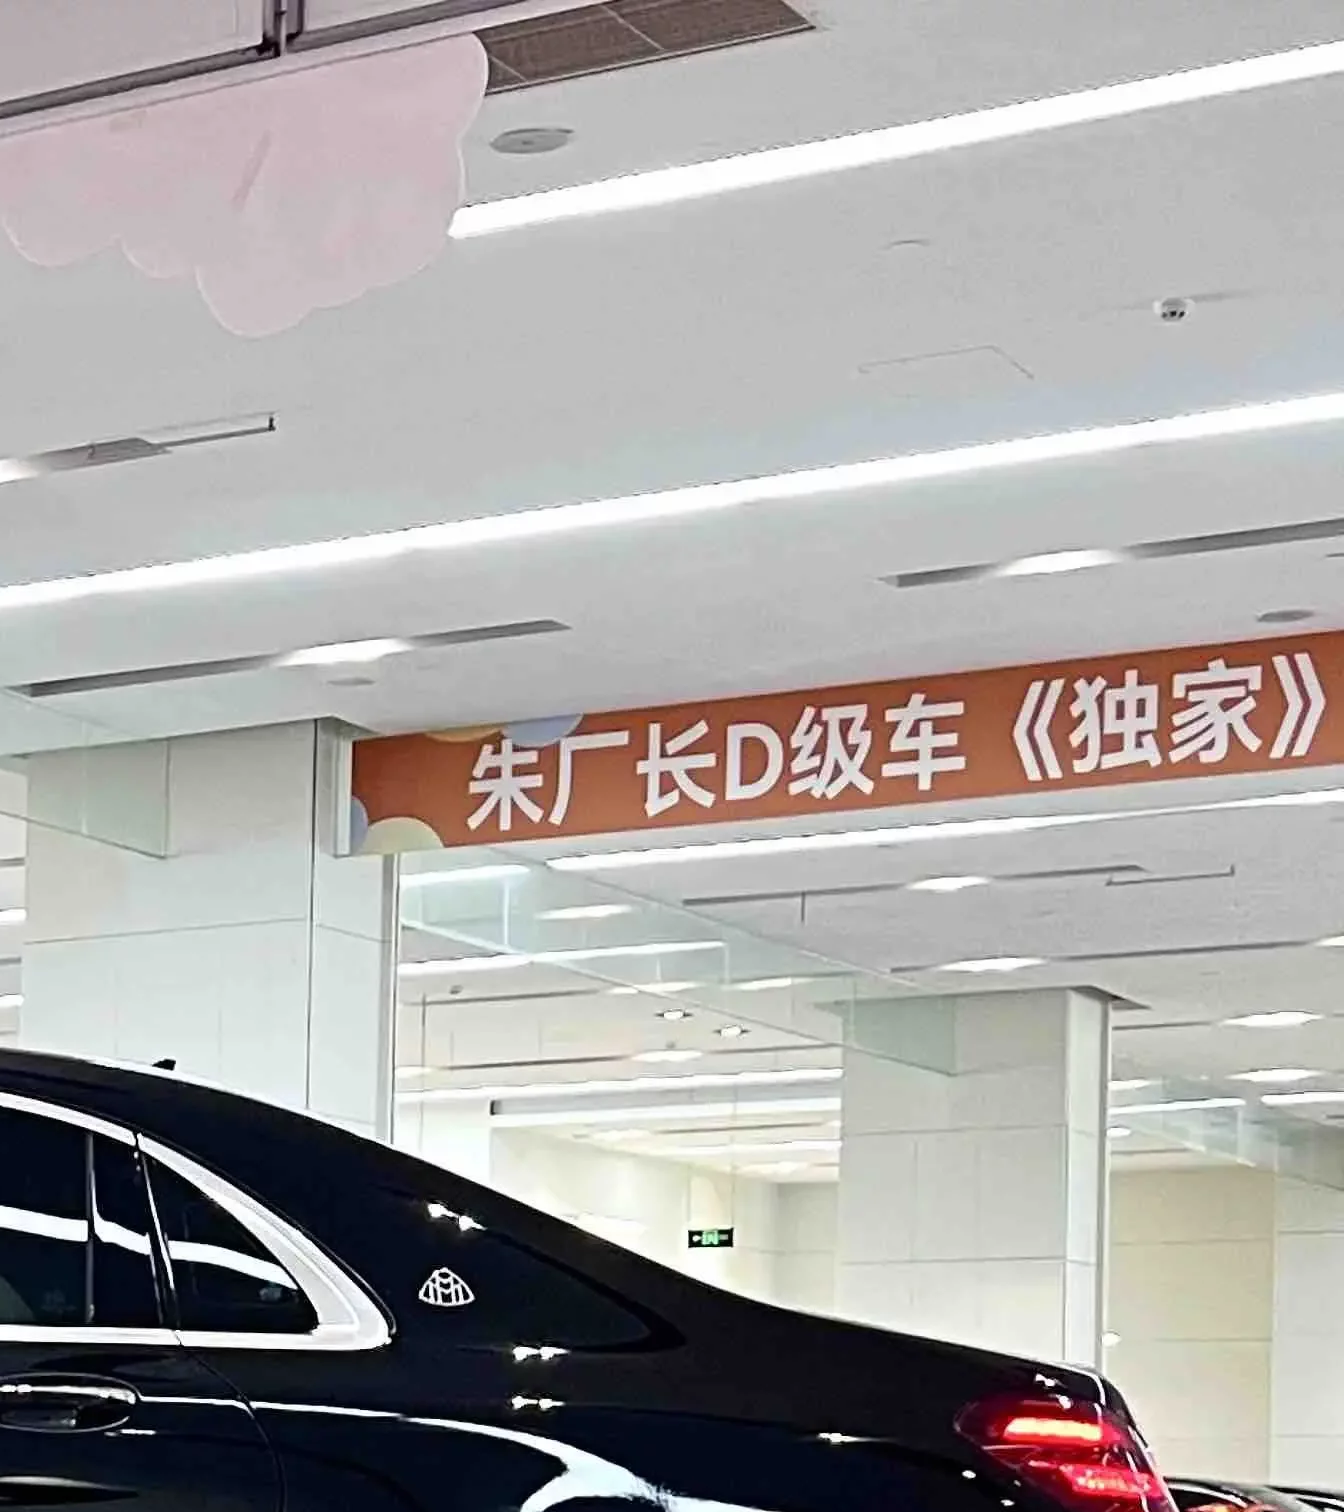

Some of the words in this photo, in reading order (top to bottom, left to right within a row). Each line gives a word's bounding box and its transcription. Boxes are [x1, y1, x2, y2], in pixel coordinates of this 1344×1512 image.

[466, 653, 1326, 832] 朱厂长D级车《独家》
